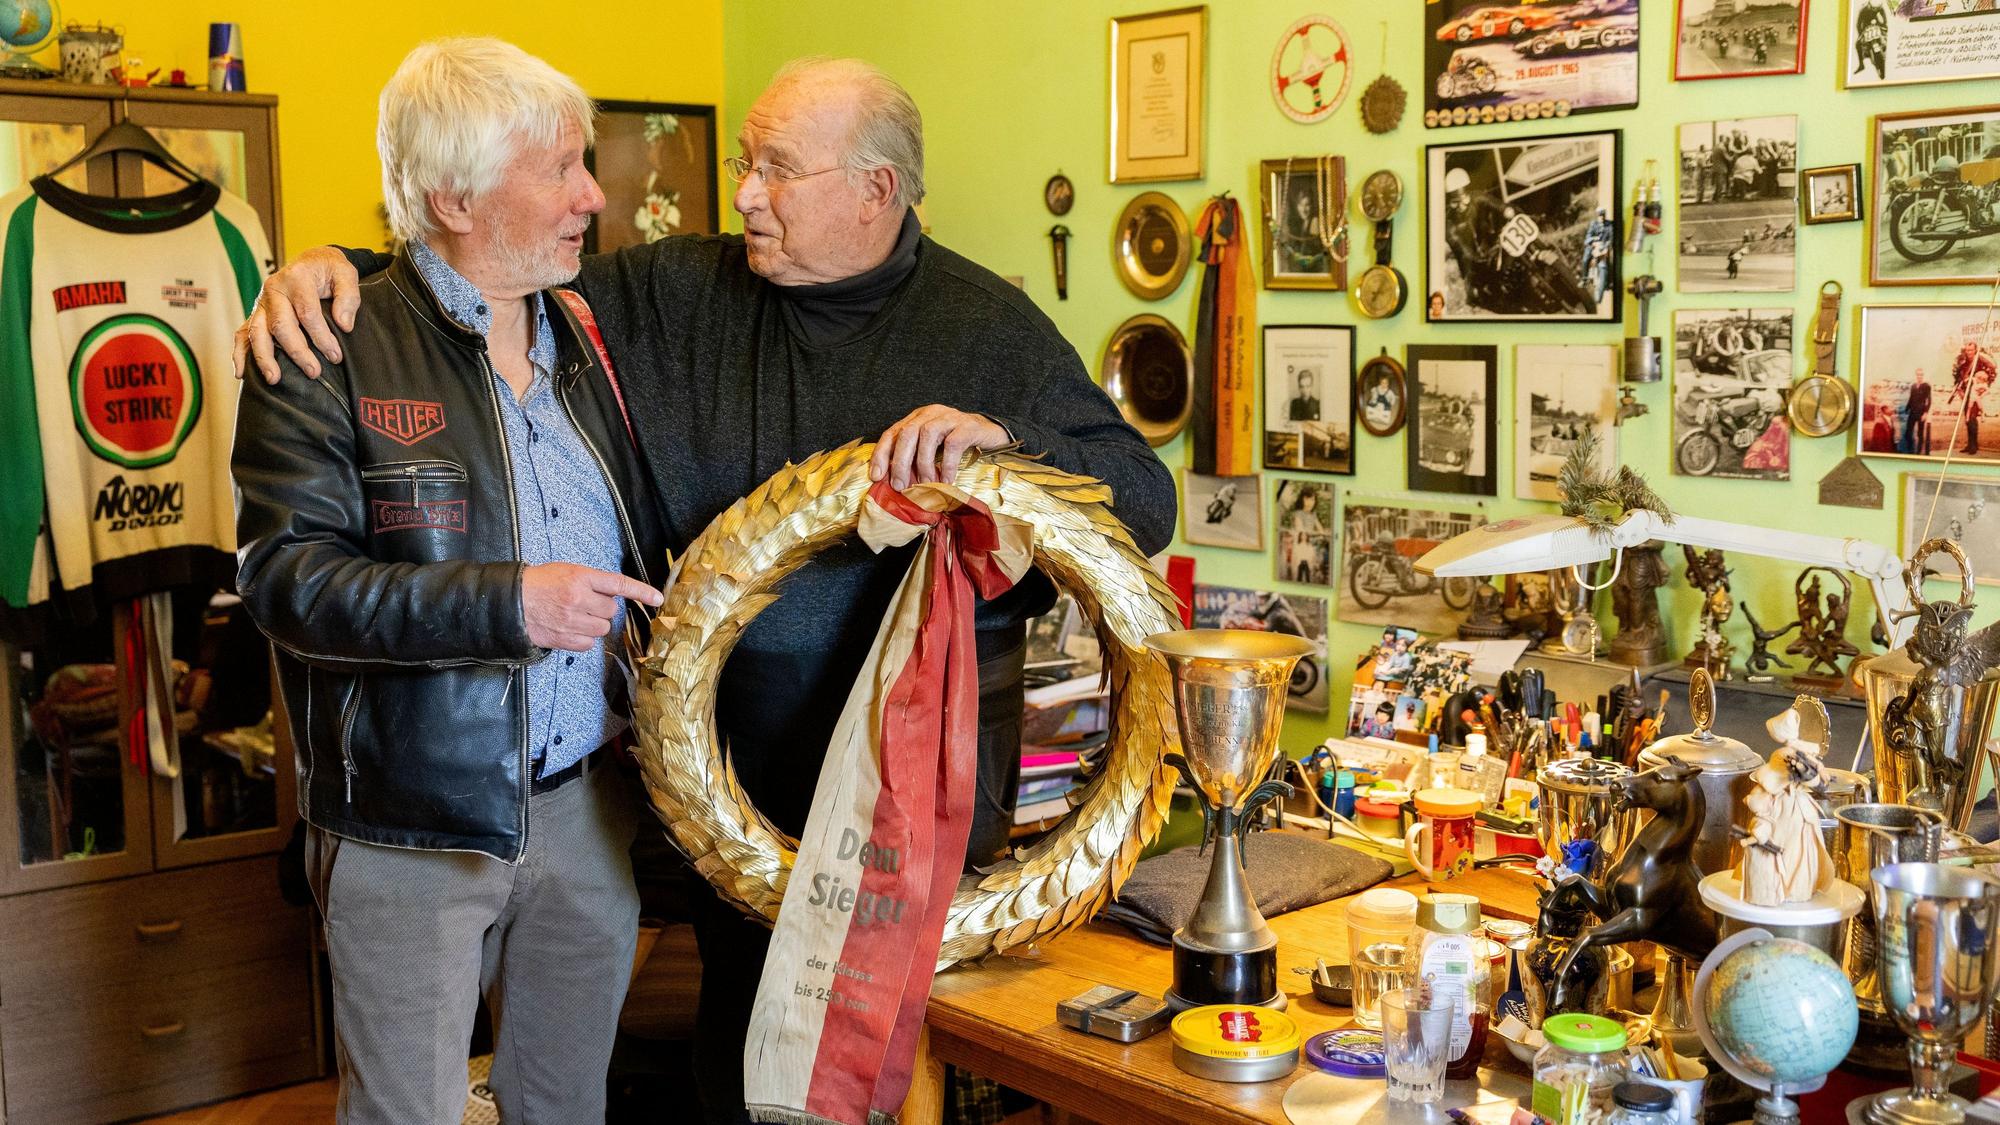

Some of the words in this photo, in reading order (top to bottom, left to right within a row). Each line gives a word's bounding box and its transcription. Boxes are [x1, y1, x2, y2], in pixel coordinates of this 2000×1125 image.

[1528, 64, 1559, 78] AUGUST
[1502, 215, 1537, 252] 130
[104, 362, 168, 390] LUCKY
[104, 396, 173, 425] STRIKE
[367, 403, 440, 439] HEUER
[836, 827, 901, 875] Dem
[808, 872, 908, 926] Sieger
[806, 954, 829, 972] der
[832, 962, 873, 983] Klasse
[794, 981, 813, 998] bis
[816, 986, 843, 1004] 250
